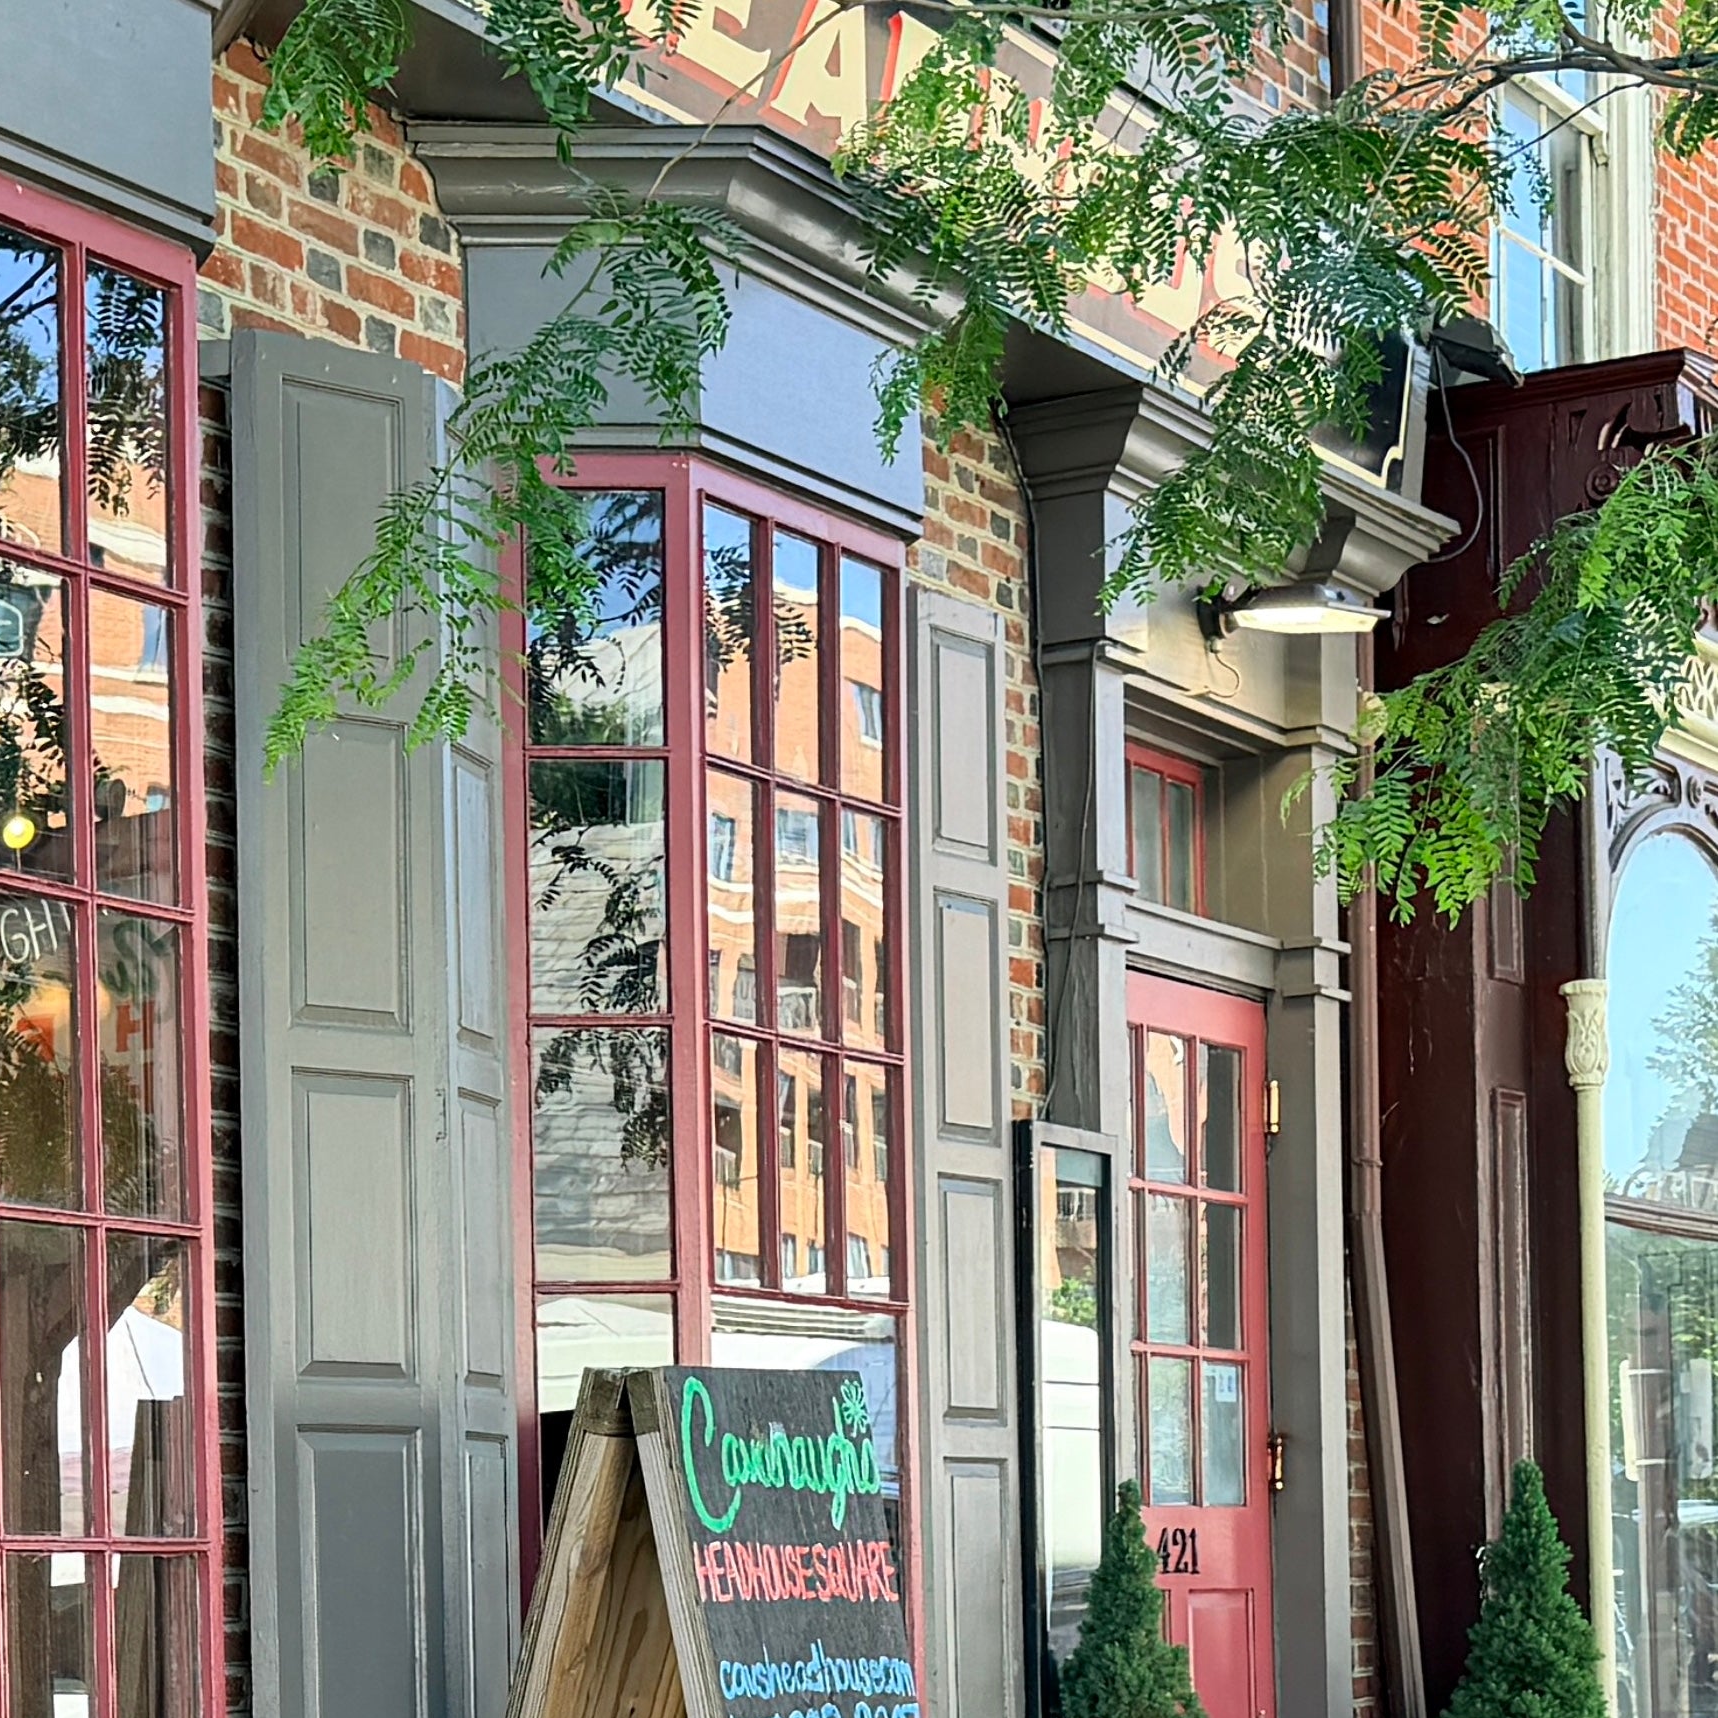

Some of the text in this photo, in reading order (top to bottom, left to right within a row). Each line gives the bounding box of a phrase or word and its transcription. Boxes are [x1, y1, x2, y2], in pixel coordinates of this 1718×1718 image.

[693, 1539, 899, 1602] HEADHOUSE SQUARE
[1157, 1527, 1200, 1574] 421
